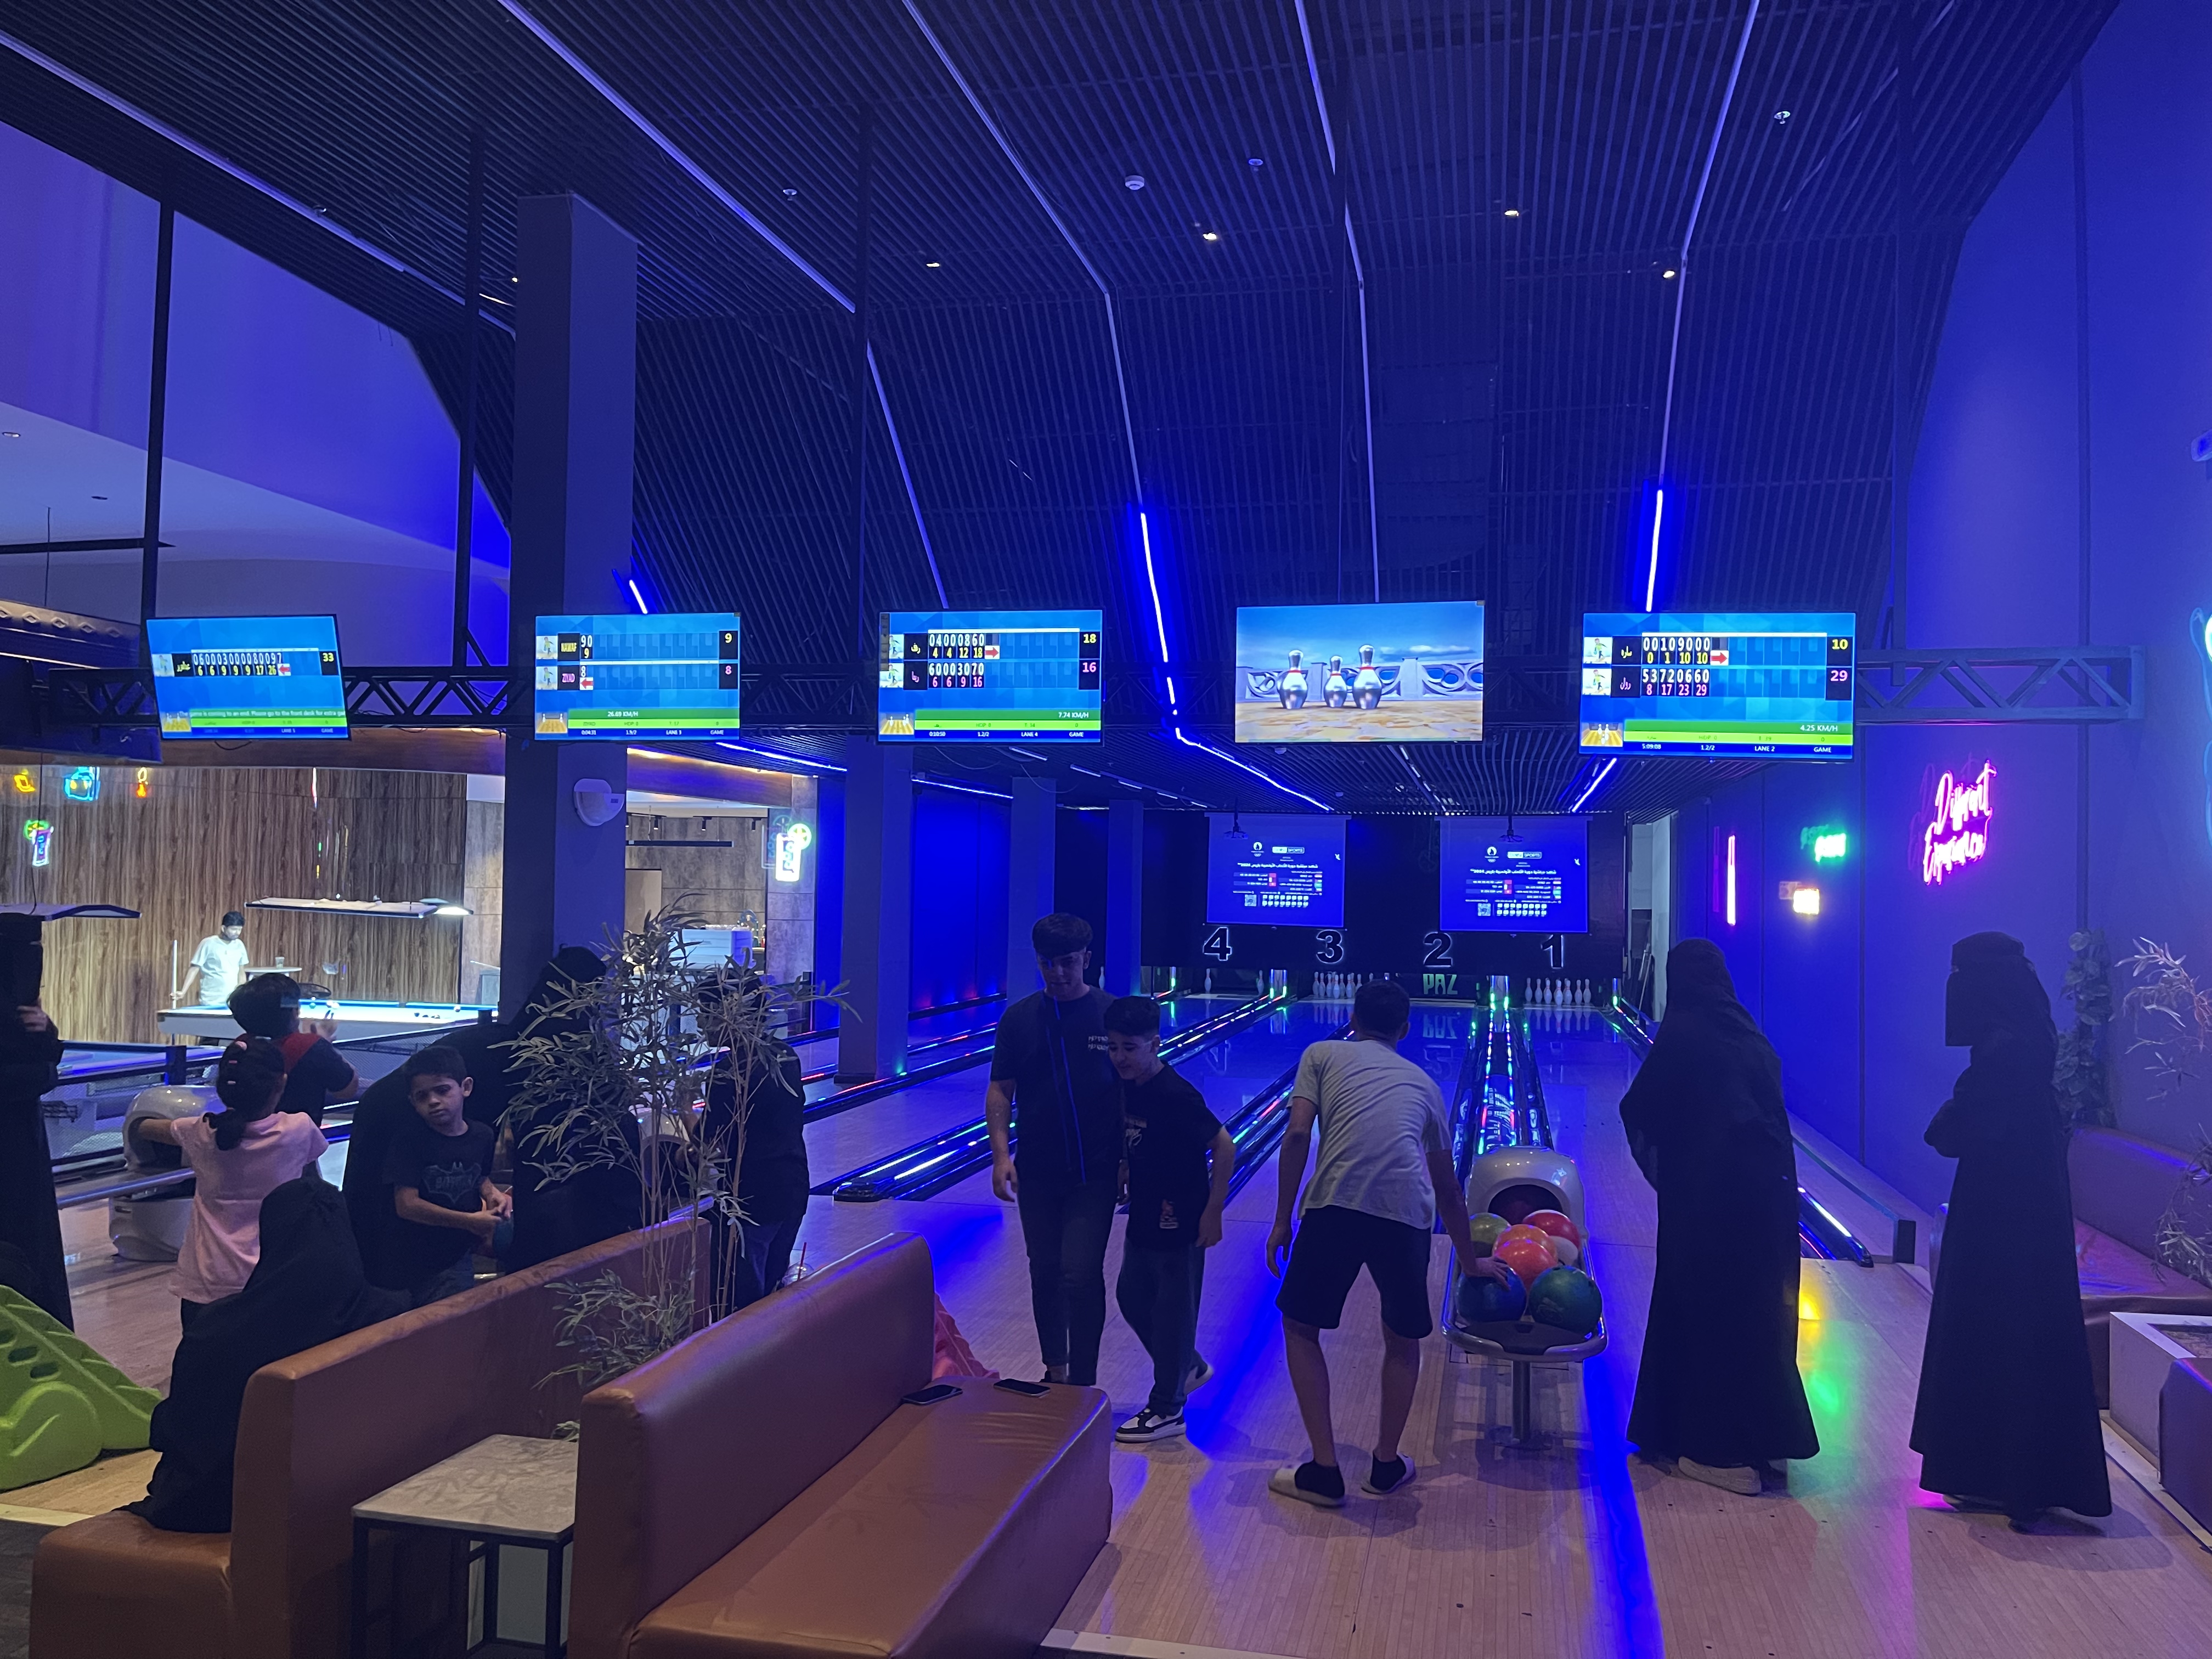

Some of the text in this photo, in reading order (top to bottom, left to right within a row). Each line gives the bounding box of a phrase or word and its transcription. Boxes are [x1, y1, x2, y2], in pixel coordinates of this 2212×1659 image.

[580, 635, 592, 648] 90
[725, 633, 732, 643] 9
[1083, 634, 1097, 644] 18
[1832, 640, 1848, 650] 10
[323, 652, 334, 662] 33
[584, 648, 590, 659] 9
[932, 647, 983, 658] 4 4 12 18
[1647, 652, 1708, 663] 0 1 10 10
[580, 665, 586, 678] 8
[725, 665, 732, 675] 8
[1082, 662, 1097, 673] 16
[932, 676, 982, 688] 6 6 9 16
[1830, 670, 1848, 682] 29
[1646, 684, 1707, 696] 8 17 23 29
[1202, 926, 1232, 961] 4
[1316, 929, 1344, 964] 3
[1423, 932, 1453, 967] 2
[1541, 933, 1564, 969] 1
[1423, 973, 1458, 995] PAZ
